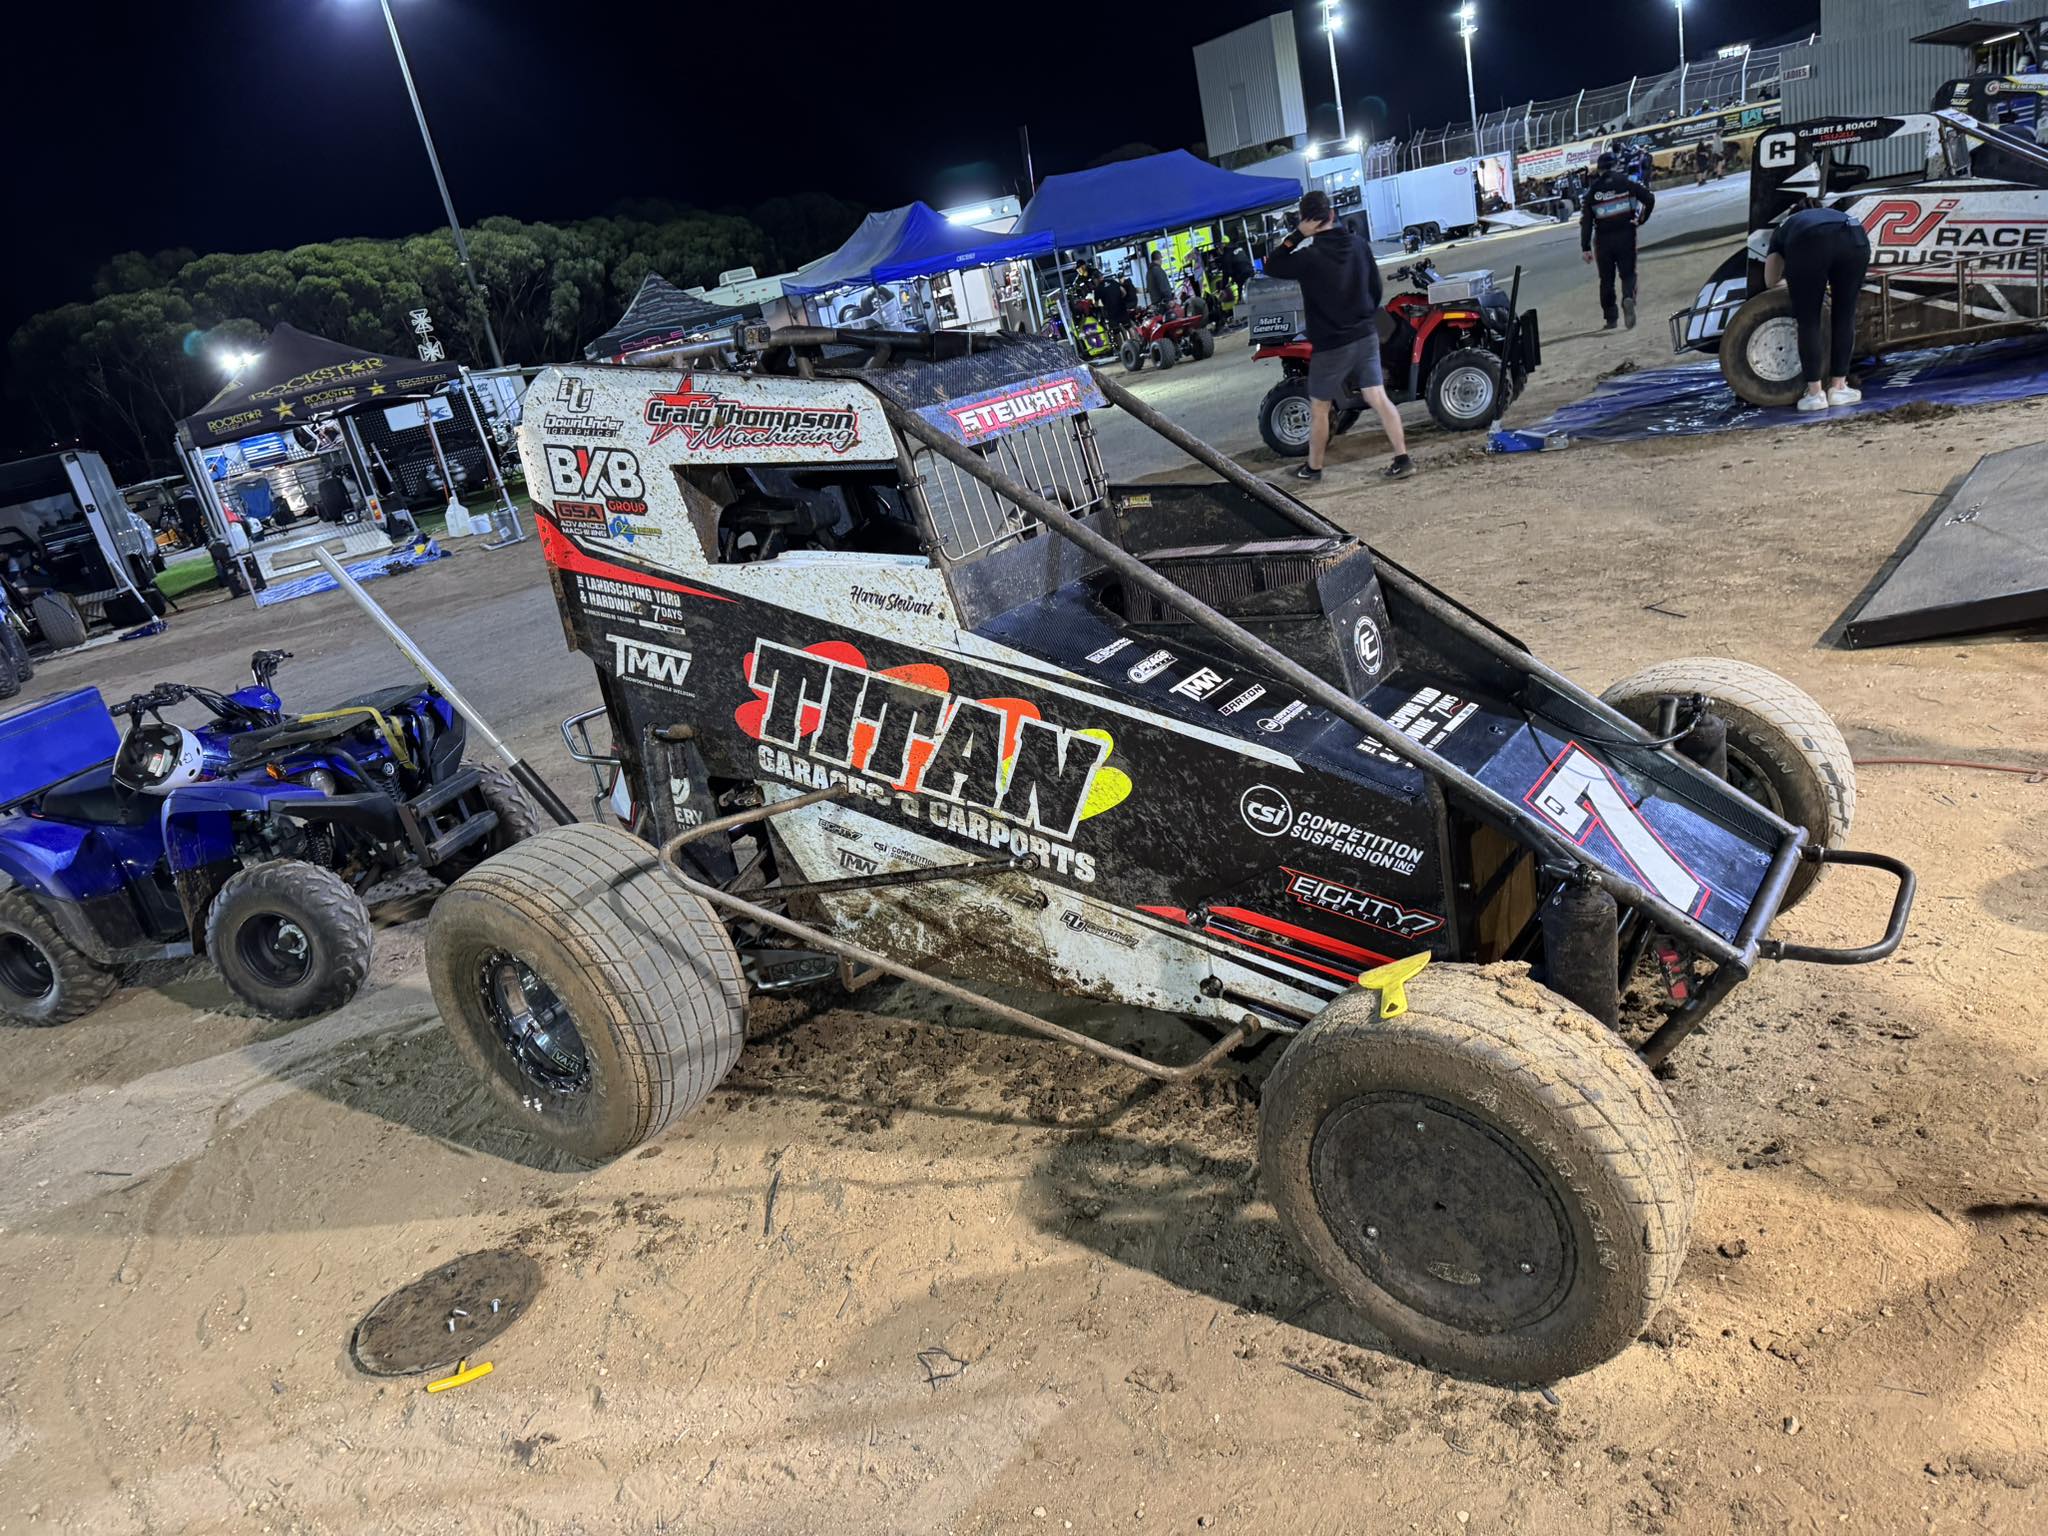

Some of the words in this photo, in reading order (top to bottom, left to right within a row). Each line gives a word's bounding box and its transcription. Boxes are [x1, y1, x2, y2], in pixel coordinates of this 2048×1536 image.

[1845, 120, 1877, 131] ROACH
[1936, 227, 2048, 247] RACE
[1871, 250, 2048, 270] DUSTRIE
[1253, 323, 1290, 333] Geering
[1259, 316, 1283, 325] Matt
[249, 357, 386, 400] ROCKSTAR
[303, 386, 357, 405] ROCKSTAR
[957, 381, 1077, 433] STEWART
[207, 409, 263, 433] ROCKSTAR
[648, 399, 711, 428] Craig
[712, 403, 855, 433] Thompson
[551, 428, 613, 438] GRAPHICS
[690, 425, 857, 450] Machining
[560, 504, 602, 519] GSA
[607, 501, 646, 514] GROUP
[561, 520, 607, 530] ADVANCED
[576, 575, 584, 588] THE
[585, 576, 653, 602] LANDSCAPING
[653, 589, 681, 608] YARD
[579, 591, 588, 604] &
[850, 585, 887, 611] Harry
[885, 593, 934, 616] Stewart
[651, 605, 661, 622] 7
[660, 606, 684, 621] DAYS
[605, 632, 693, 686] TMW
[1169, 666, 1223, 701] TMW
[1221, 684, 1264, 715] BARTON
[748, 636, 1109, 842] TITAN
[928, 800, 1097, 883] CARPORTS
[1297, 811, 1424, 864] COMPETITION
[1527, 743, 1707, 917] 7
[837, 847, 879, 875] TMW
[1290, 824, 1395, 869] SUSPENSION
[1393, 859, 1417, 874] INC
[1303, 894, 1411, 935] CREATIVE
